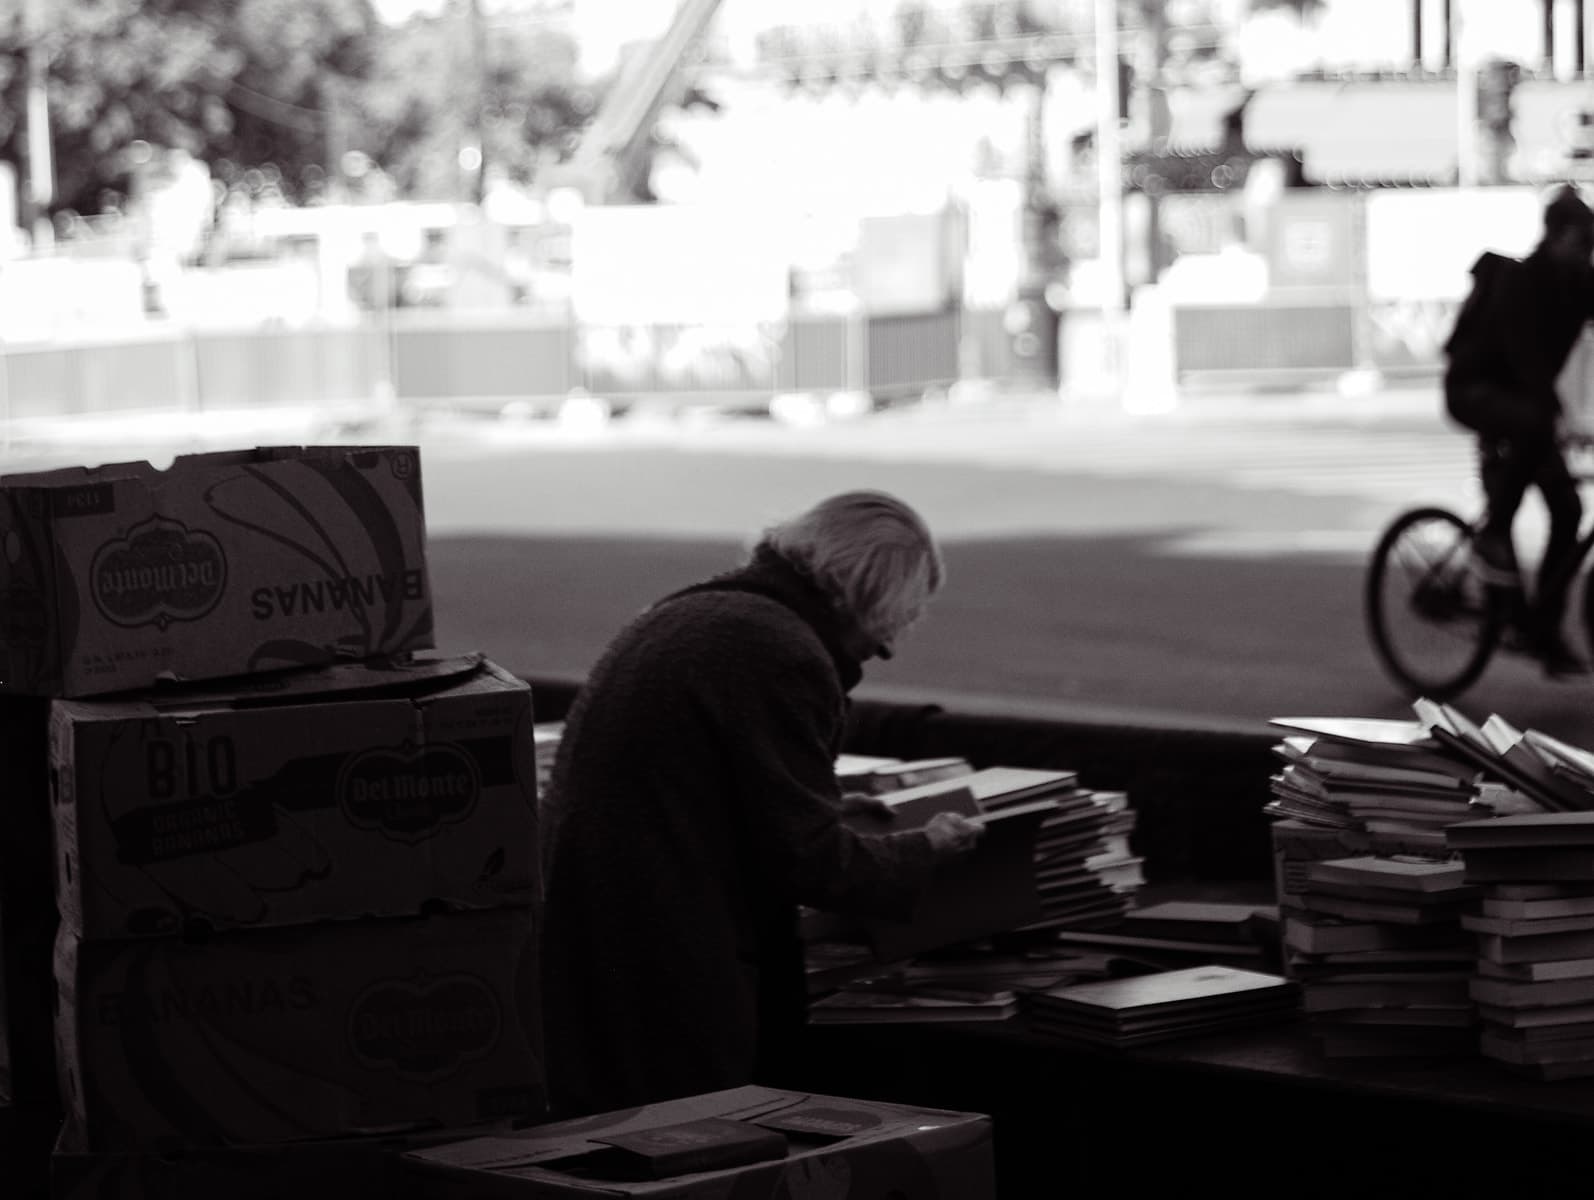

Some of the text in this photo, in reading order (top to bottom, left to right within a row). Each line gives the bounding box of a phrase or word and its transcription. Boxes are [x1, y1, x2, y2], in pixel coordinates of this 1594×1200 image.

[102, 565, 176, 595] Monte
[249, 570, 424, 621] BANANAS
[146, 736, 236, 797] BIO
[352, 772, 468, 802] Del Monte
[97, 976, 321, 1025] BNANAS
